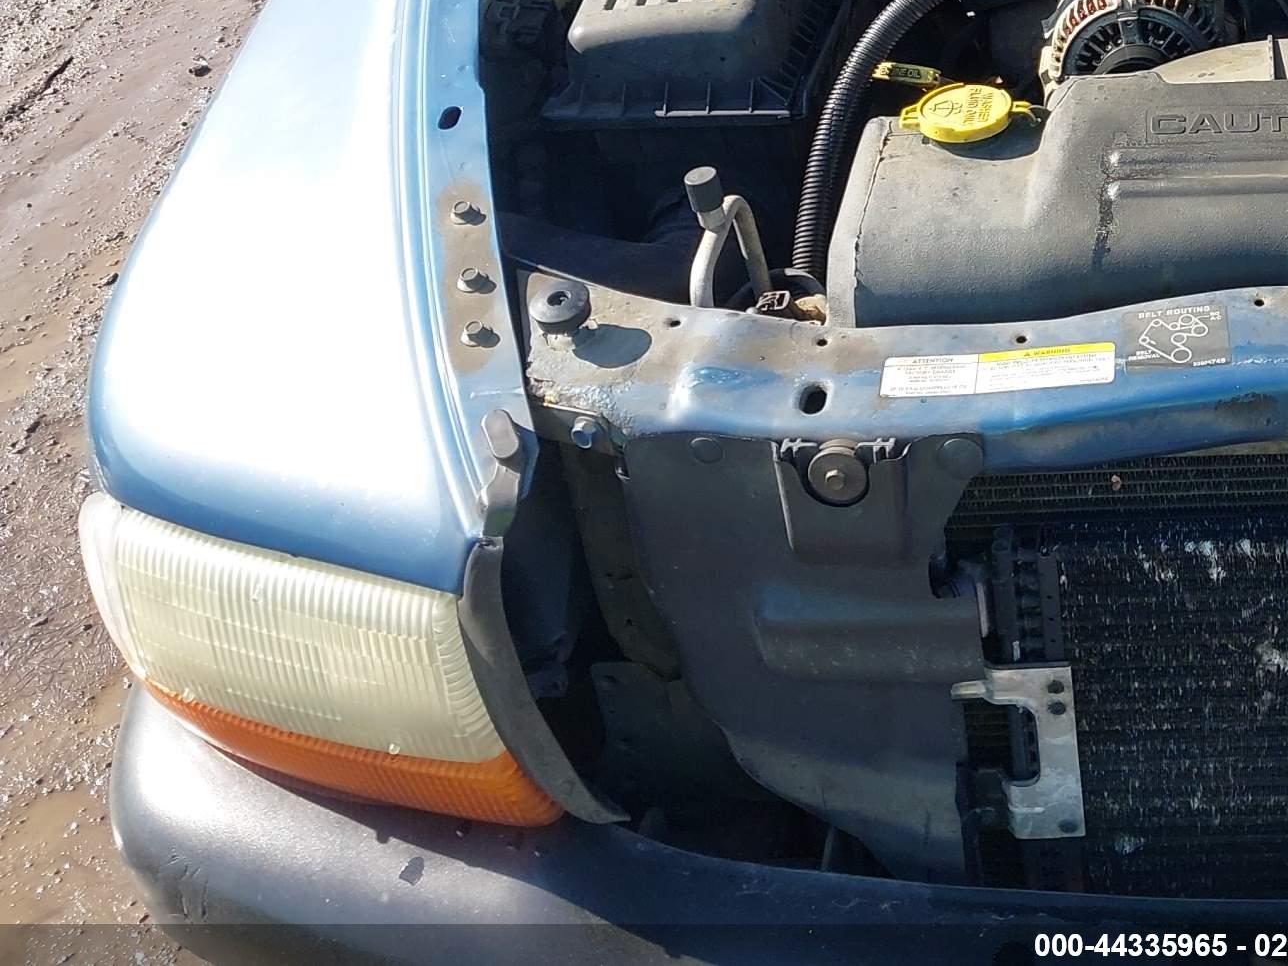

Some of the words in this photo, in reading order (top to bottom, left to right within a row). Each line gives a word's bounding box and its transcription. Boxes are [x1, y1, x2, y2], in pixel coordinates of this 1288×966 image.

[1138, 310, 1162, 319] BELT
[1166, 305, 1212, 316] ROUTING
[912, 357, 954, 365] ATTENTION
